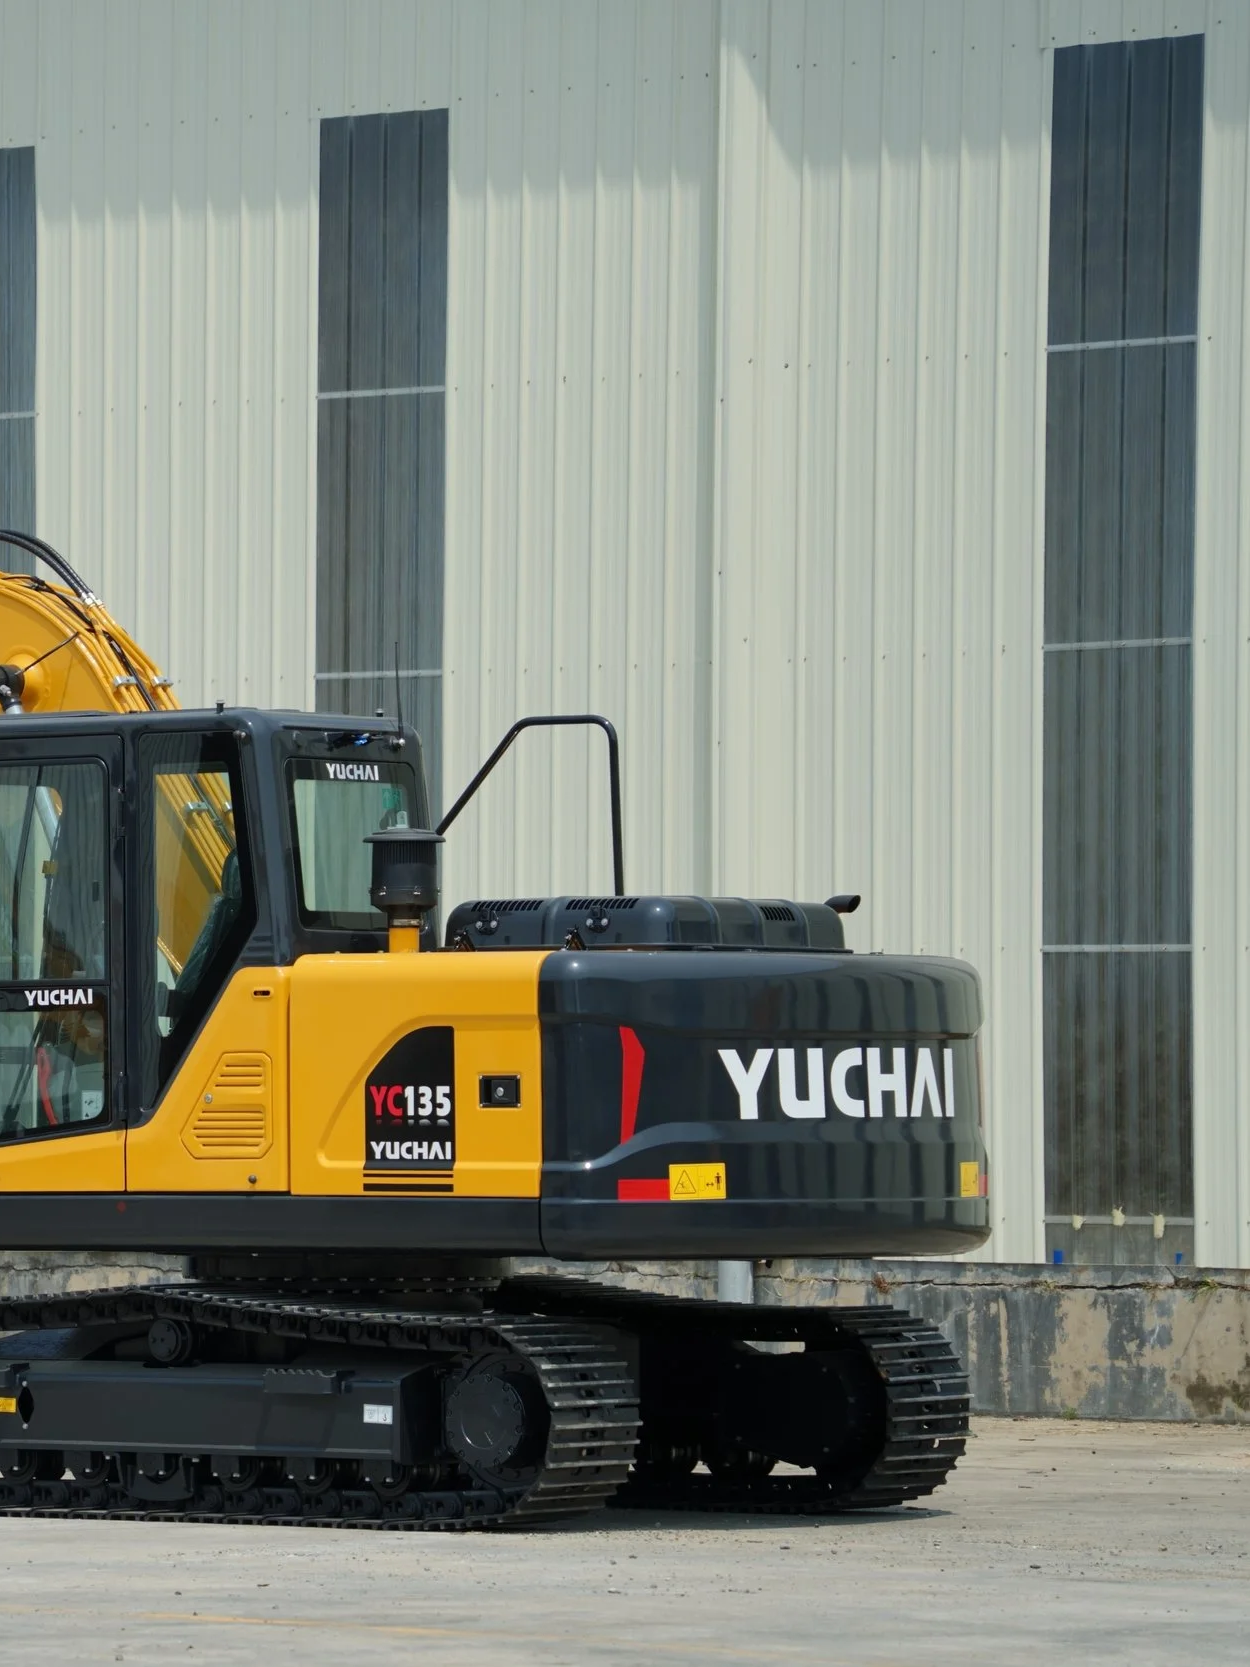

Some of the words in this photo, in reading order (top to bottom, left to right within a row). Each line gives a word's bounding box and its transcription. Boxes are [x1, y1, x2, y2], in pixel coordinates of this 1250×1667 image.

[325, 762, 380, 781] YUCHAI
[24, 988, 93, 1006] YUCHAI
[717, 1047, 955, 1119] YUCHAI
[369, 1085, 451, 1117] YC135
[370, 1141, 452, 1160] YUCHAI
